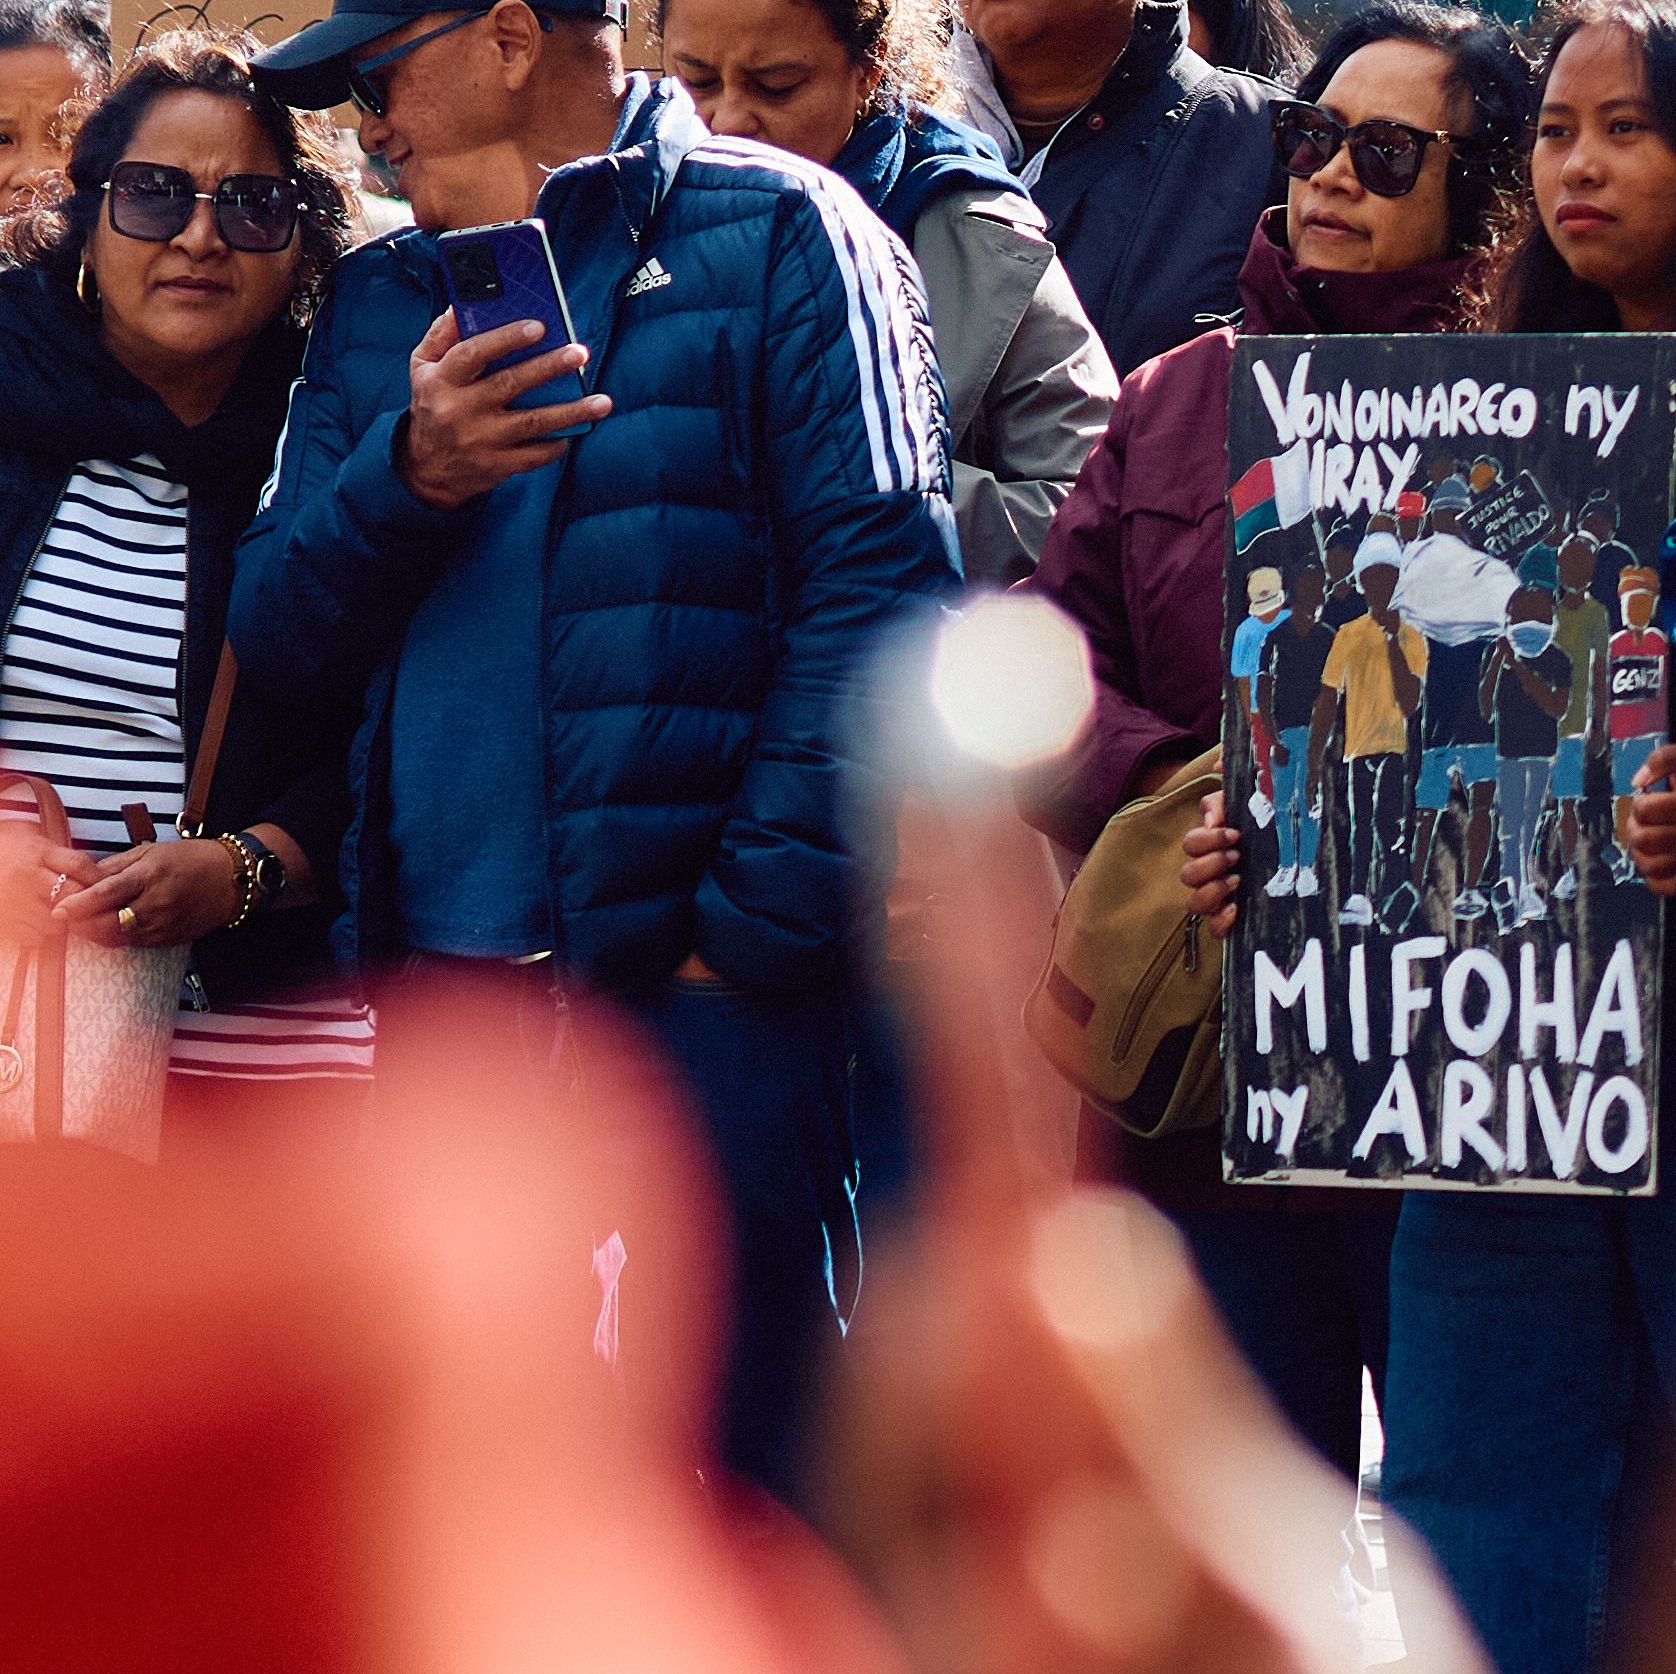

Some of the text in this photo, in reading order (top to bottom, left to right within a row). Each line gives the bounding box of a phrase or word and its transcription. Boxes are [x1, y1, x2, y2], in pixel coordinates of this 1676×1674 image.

[1564, 384, 1640, 458] ny
[1309, 438, 1424, 520] IRAY
[1467, 485, 1526, 530] JUSTICE
[1253, 936, 1644, 1068] MIFOHA
[1246, 1057, 1649, 1179] ny ARIVO
